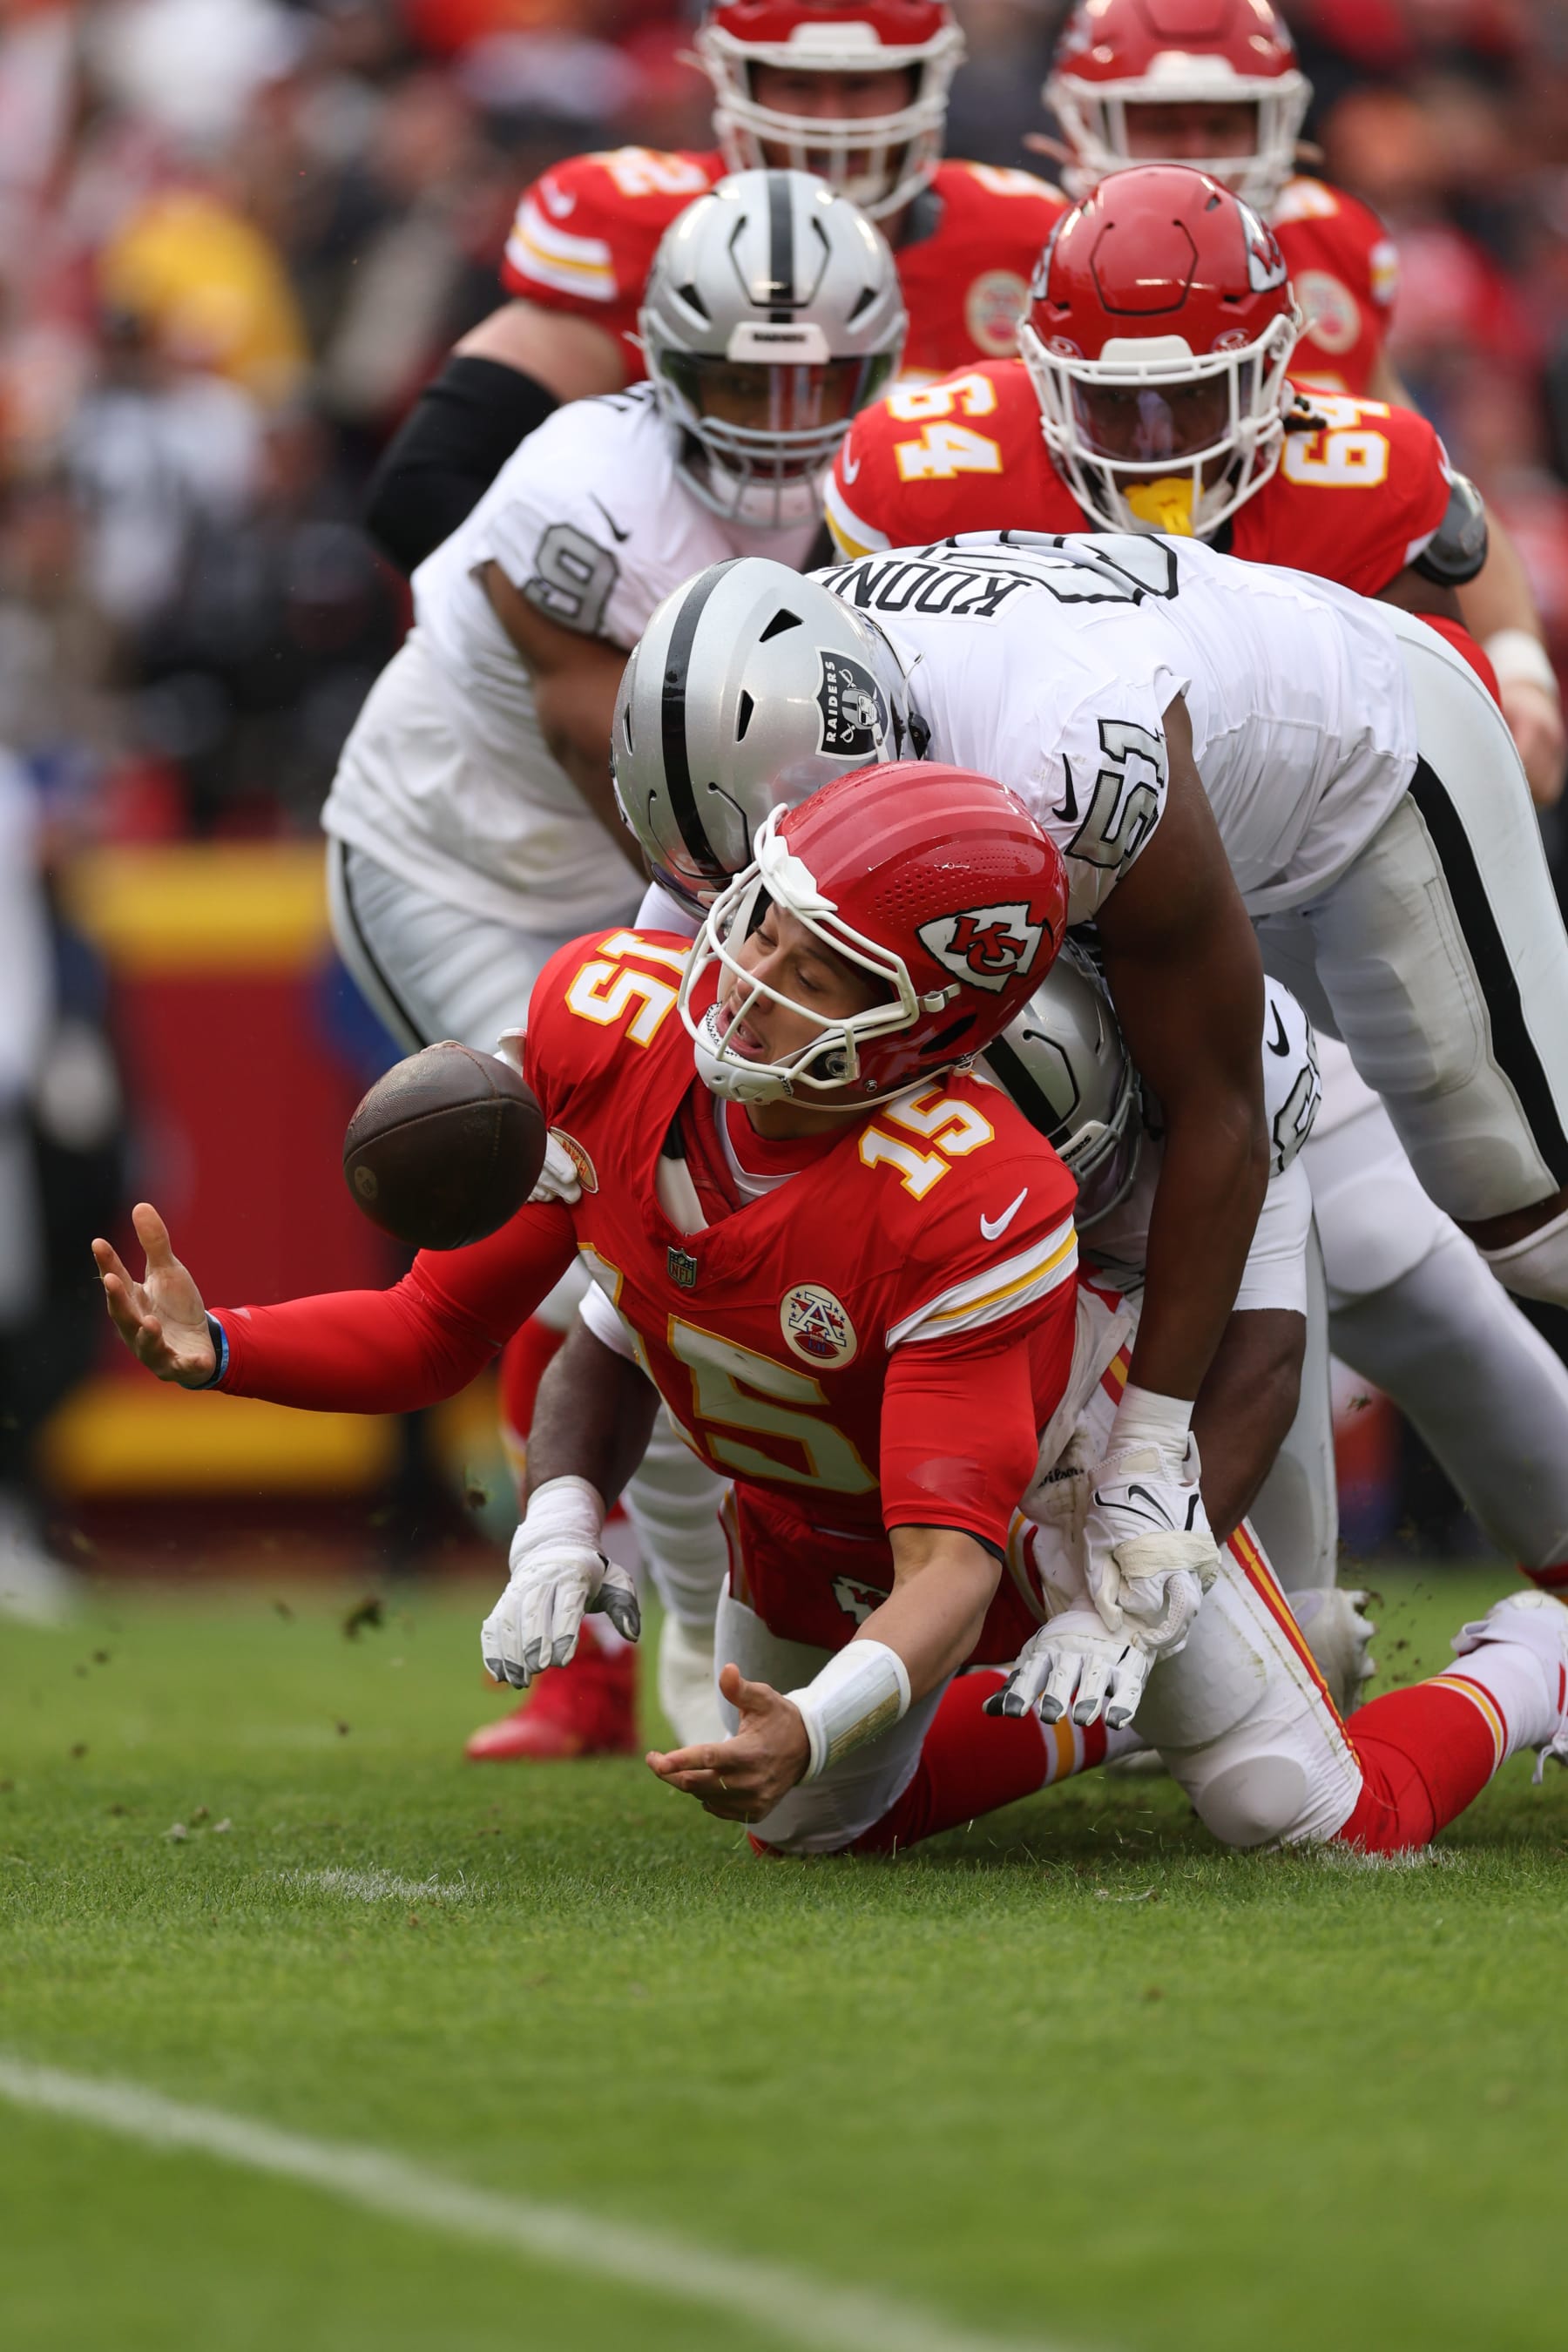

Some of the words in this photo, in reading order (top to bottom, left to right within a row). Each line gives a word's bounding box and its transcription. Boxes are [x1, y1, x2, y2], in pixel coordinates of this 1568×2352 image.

[886, 373, 1004, 482] 64
[1281, 392, 1390, 488] 64
[824, 660, 839, 743] RAIDERS
[564, 929, 693, 1049] 15
[944, 915, 1029, 977] KC
[858, 1080, 995, 1201] 15
[672, 1263, 692, 1284] NFL
